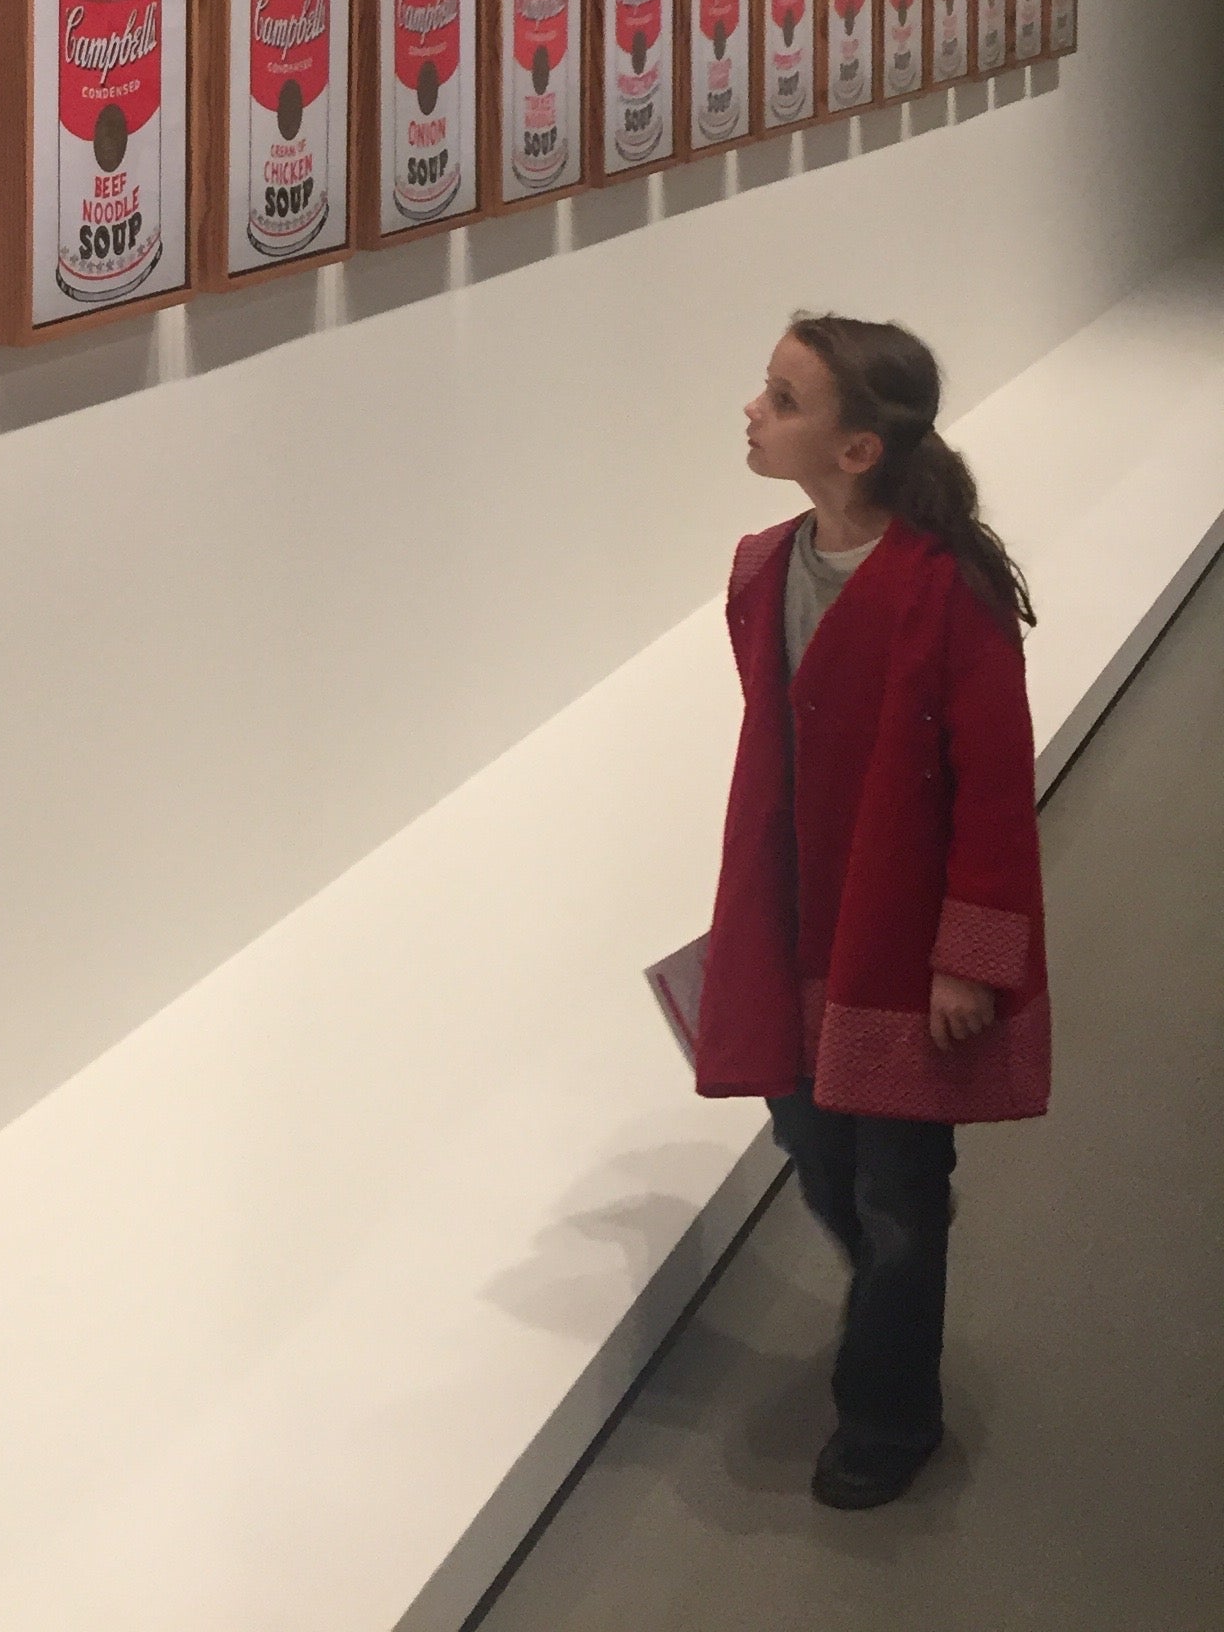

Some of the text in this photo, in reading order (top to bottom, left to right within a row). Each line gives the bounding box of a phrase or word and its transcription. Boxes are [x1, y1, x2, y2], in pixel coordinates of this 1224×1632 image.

[81, 80, 141, 99] CONDENSED
[94, 172, 127, 198] BEEF
[264, 153, 313, 186] CHICKEN
[408, 149, 449, 186] SOUP
[83, 185, 140, 224] NOODLE
[265, 176, 314, 218] SOUP
[79, 212, 142, 259] SOUP
